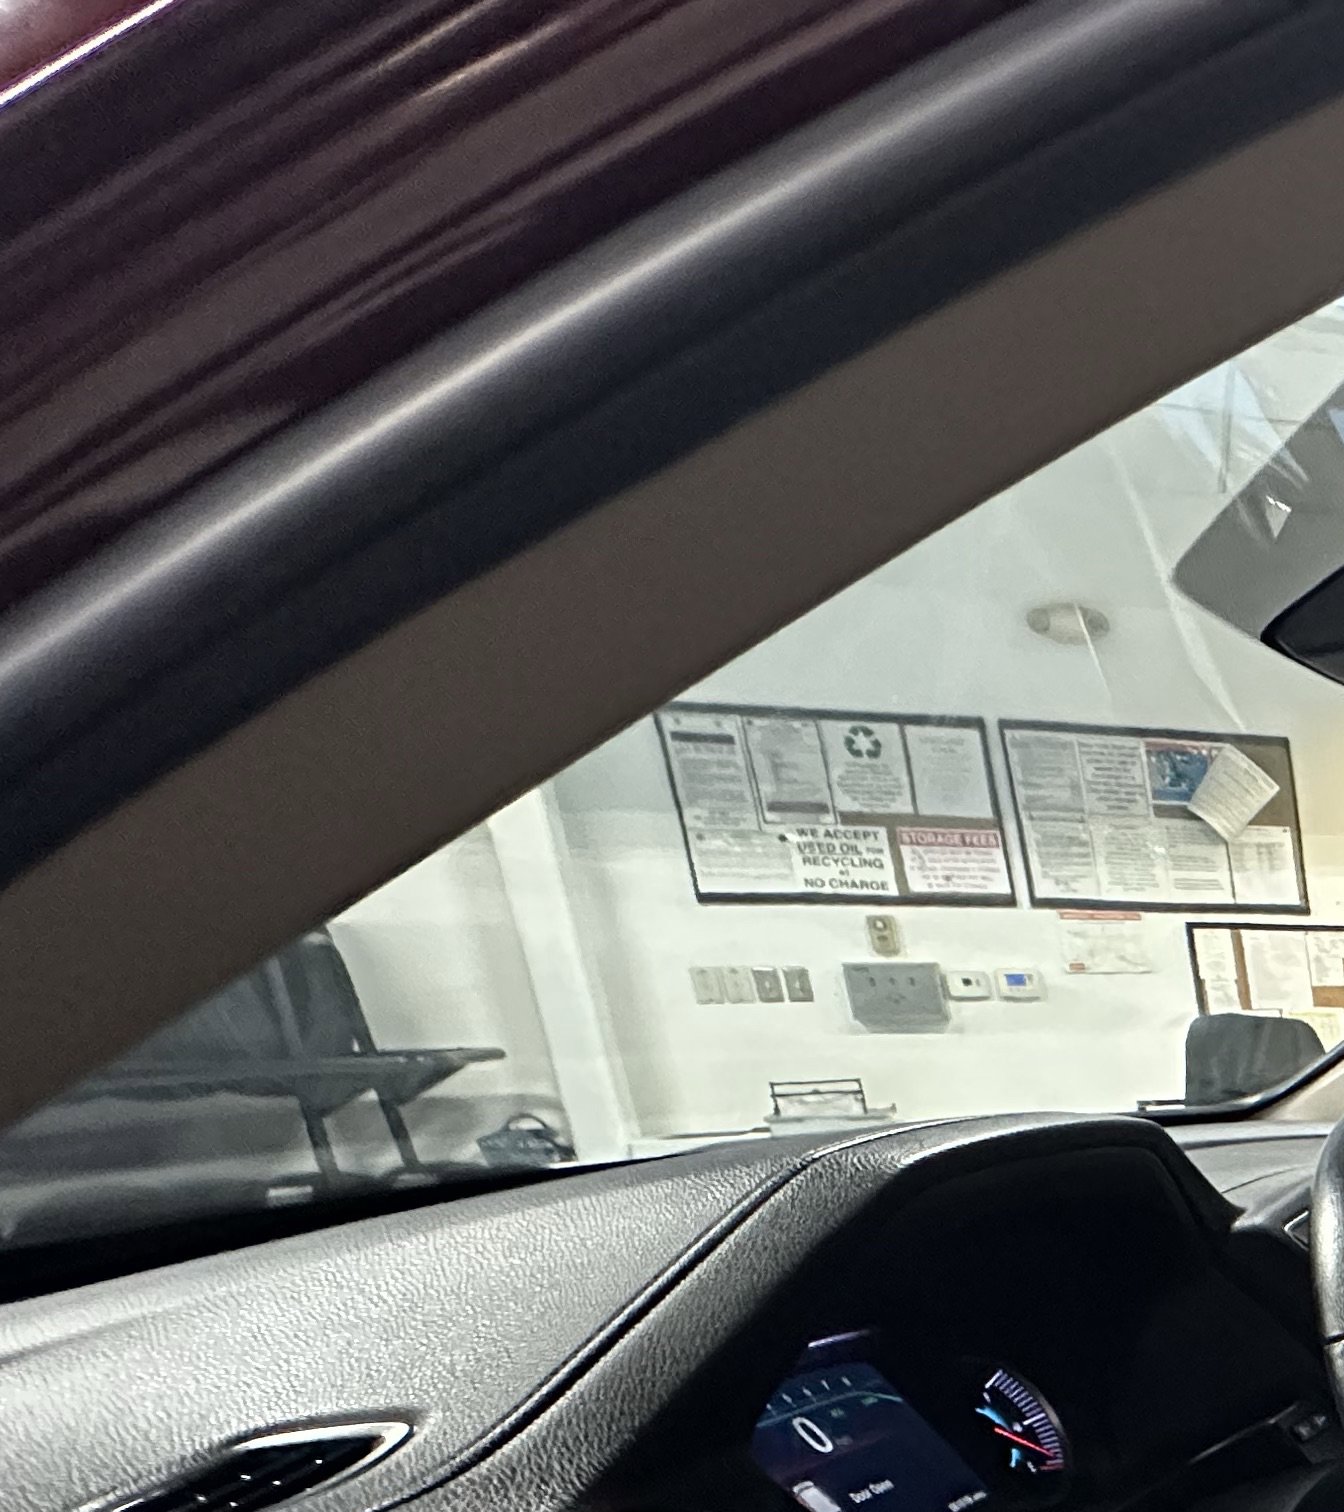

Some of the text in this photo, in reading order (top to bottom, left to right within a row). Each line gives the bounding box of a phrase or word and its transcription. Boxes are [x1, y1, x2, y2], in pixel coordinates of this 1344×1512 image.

[796, 828, 879, 841] WE ACCEPT
[901, 831, 998, 846] STORAGE FEES
[797, 841, 837, 855] USED
[840, 842, 863, 855] OIL
[802, 856, 884, 869] RECYCLING
[804, 877, 889, 891] NO CHARGE
[792, 1416, 834, 1453] 0
